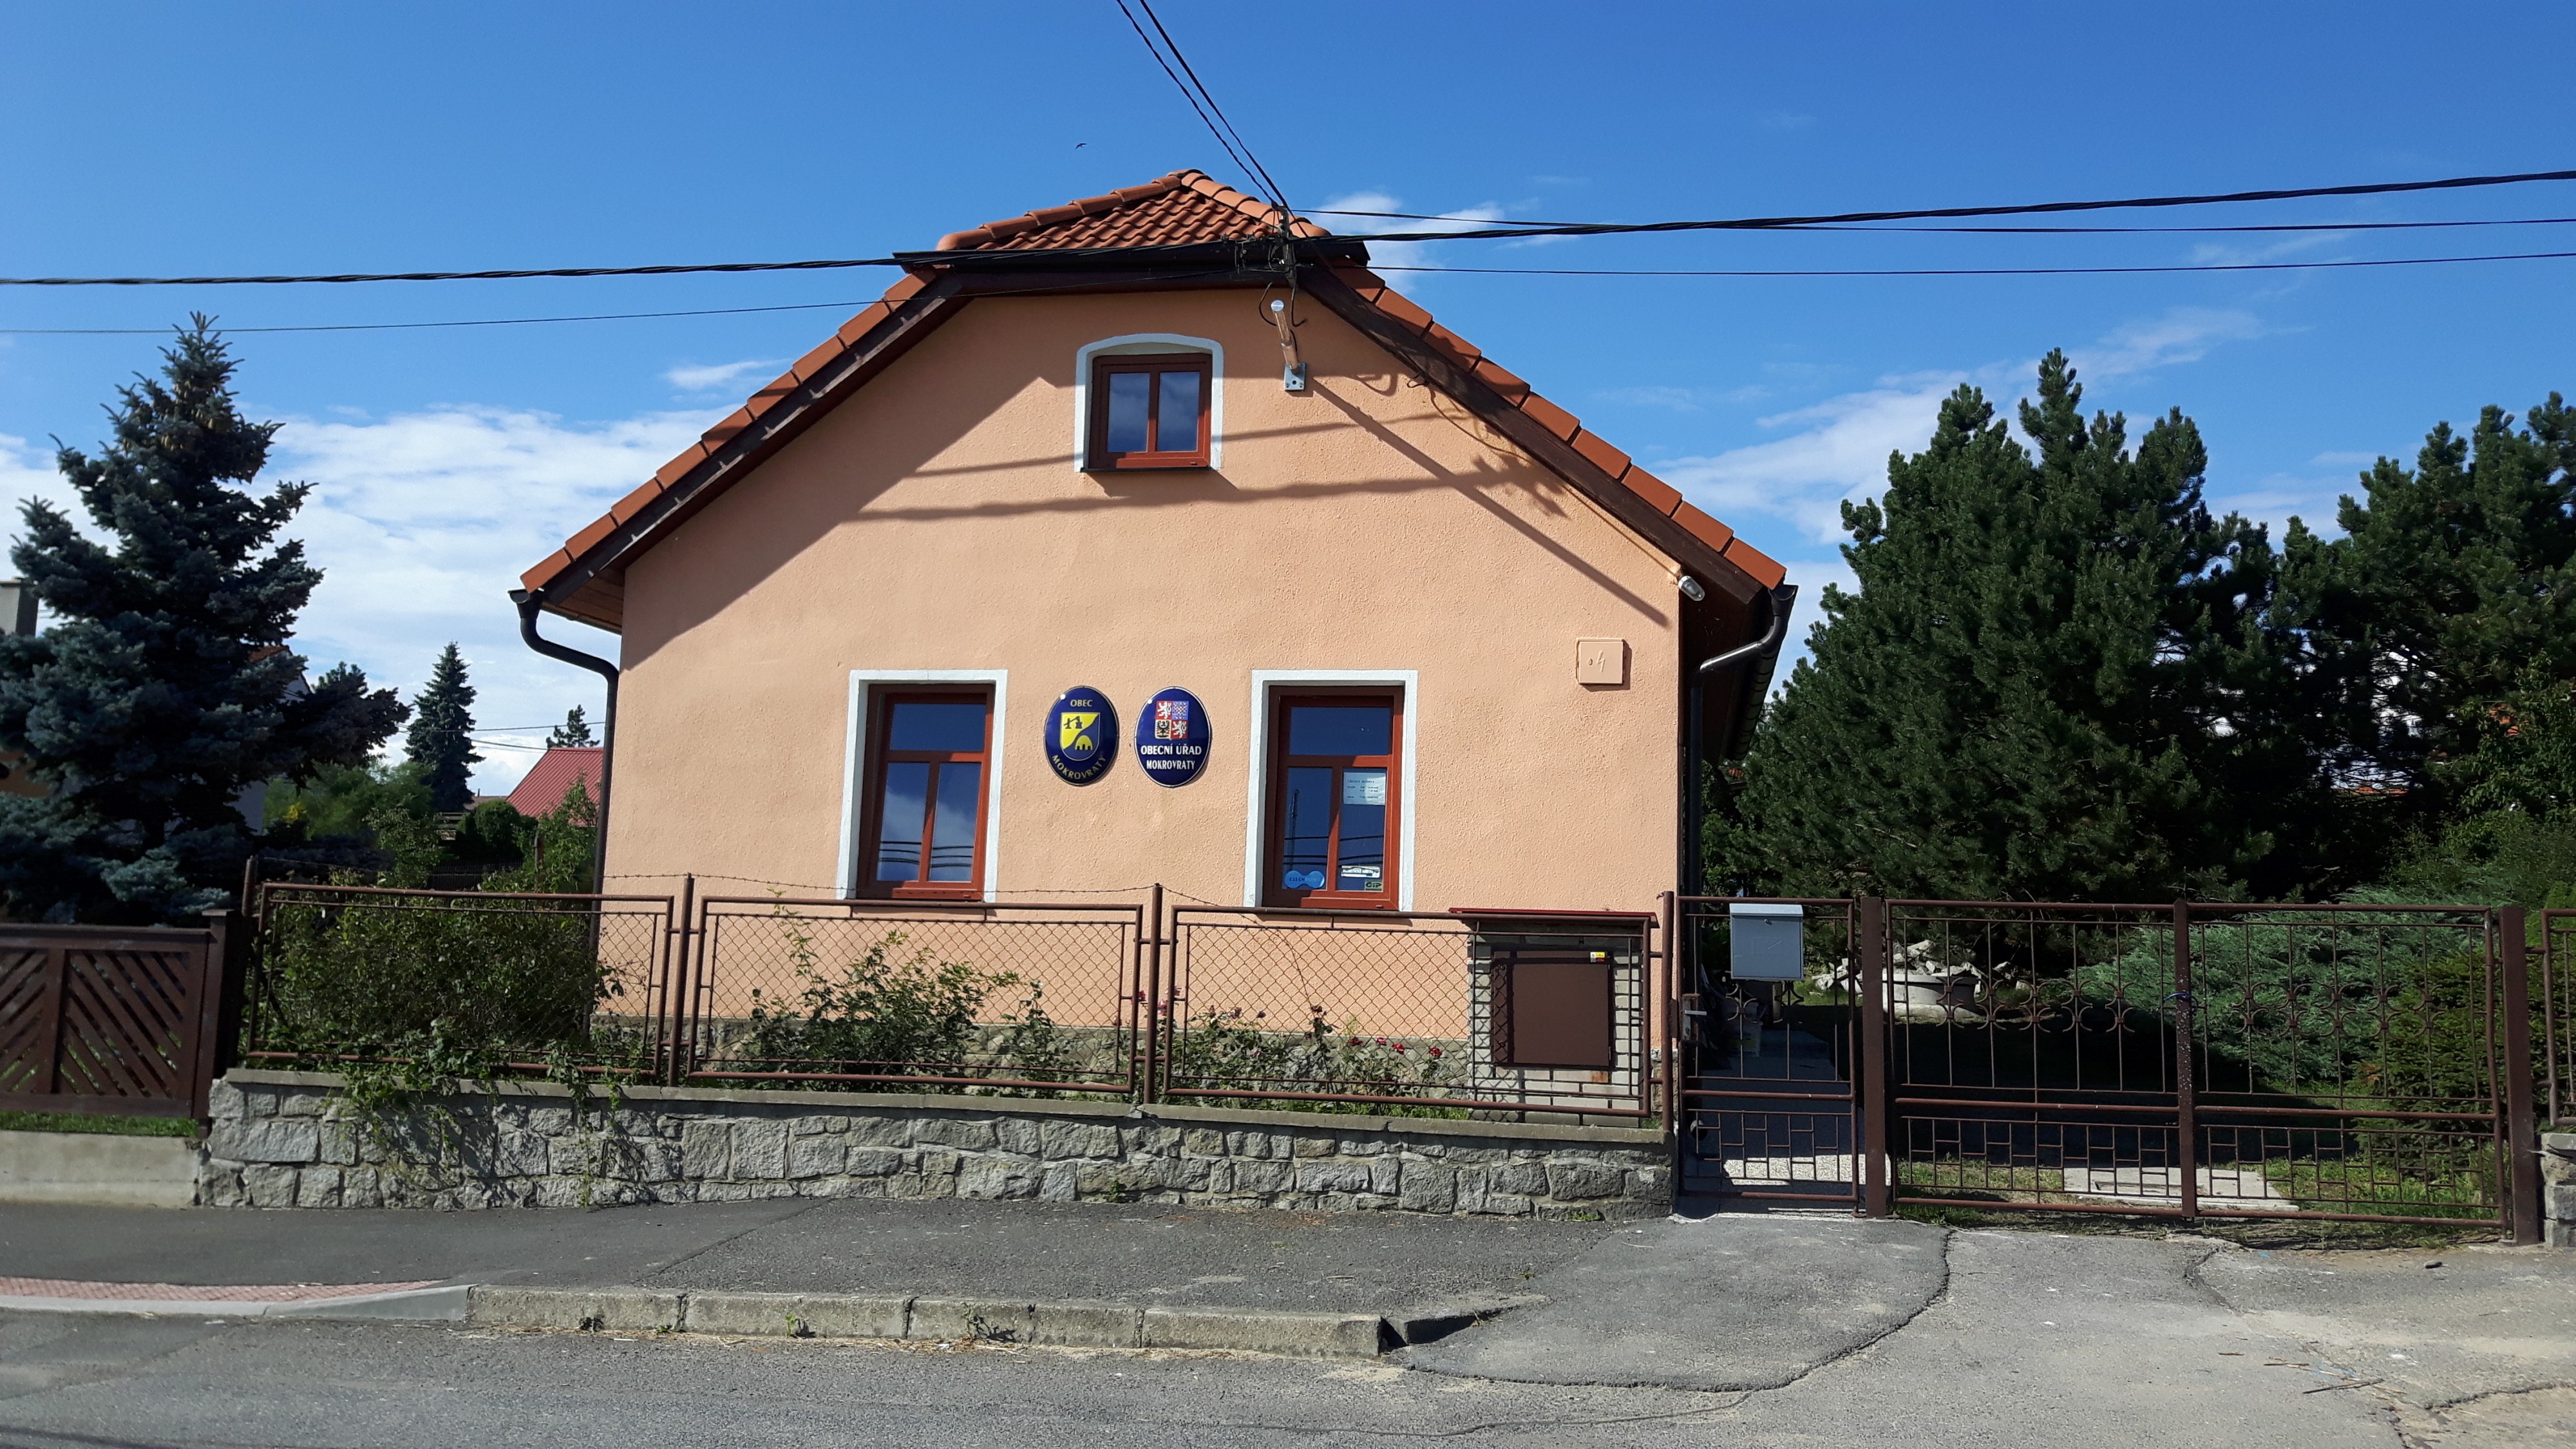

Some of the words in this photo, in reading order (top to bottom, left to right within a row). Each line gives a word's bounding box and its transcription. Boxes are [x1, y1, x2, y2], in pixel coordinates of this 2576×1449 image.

[1141, 743, 1173, 755] OBECNÍ
[1176, 743, 1202, 755] ÚŘAD
[1052, 754, 1106, 780] MOKROVRATY
[1146, 760, 1195, 770] MOKROVRATY
